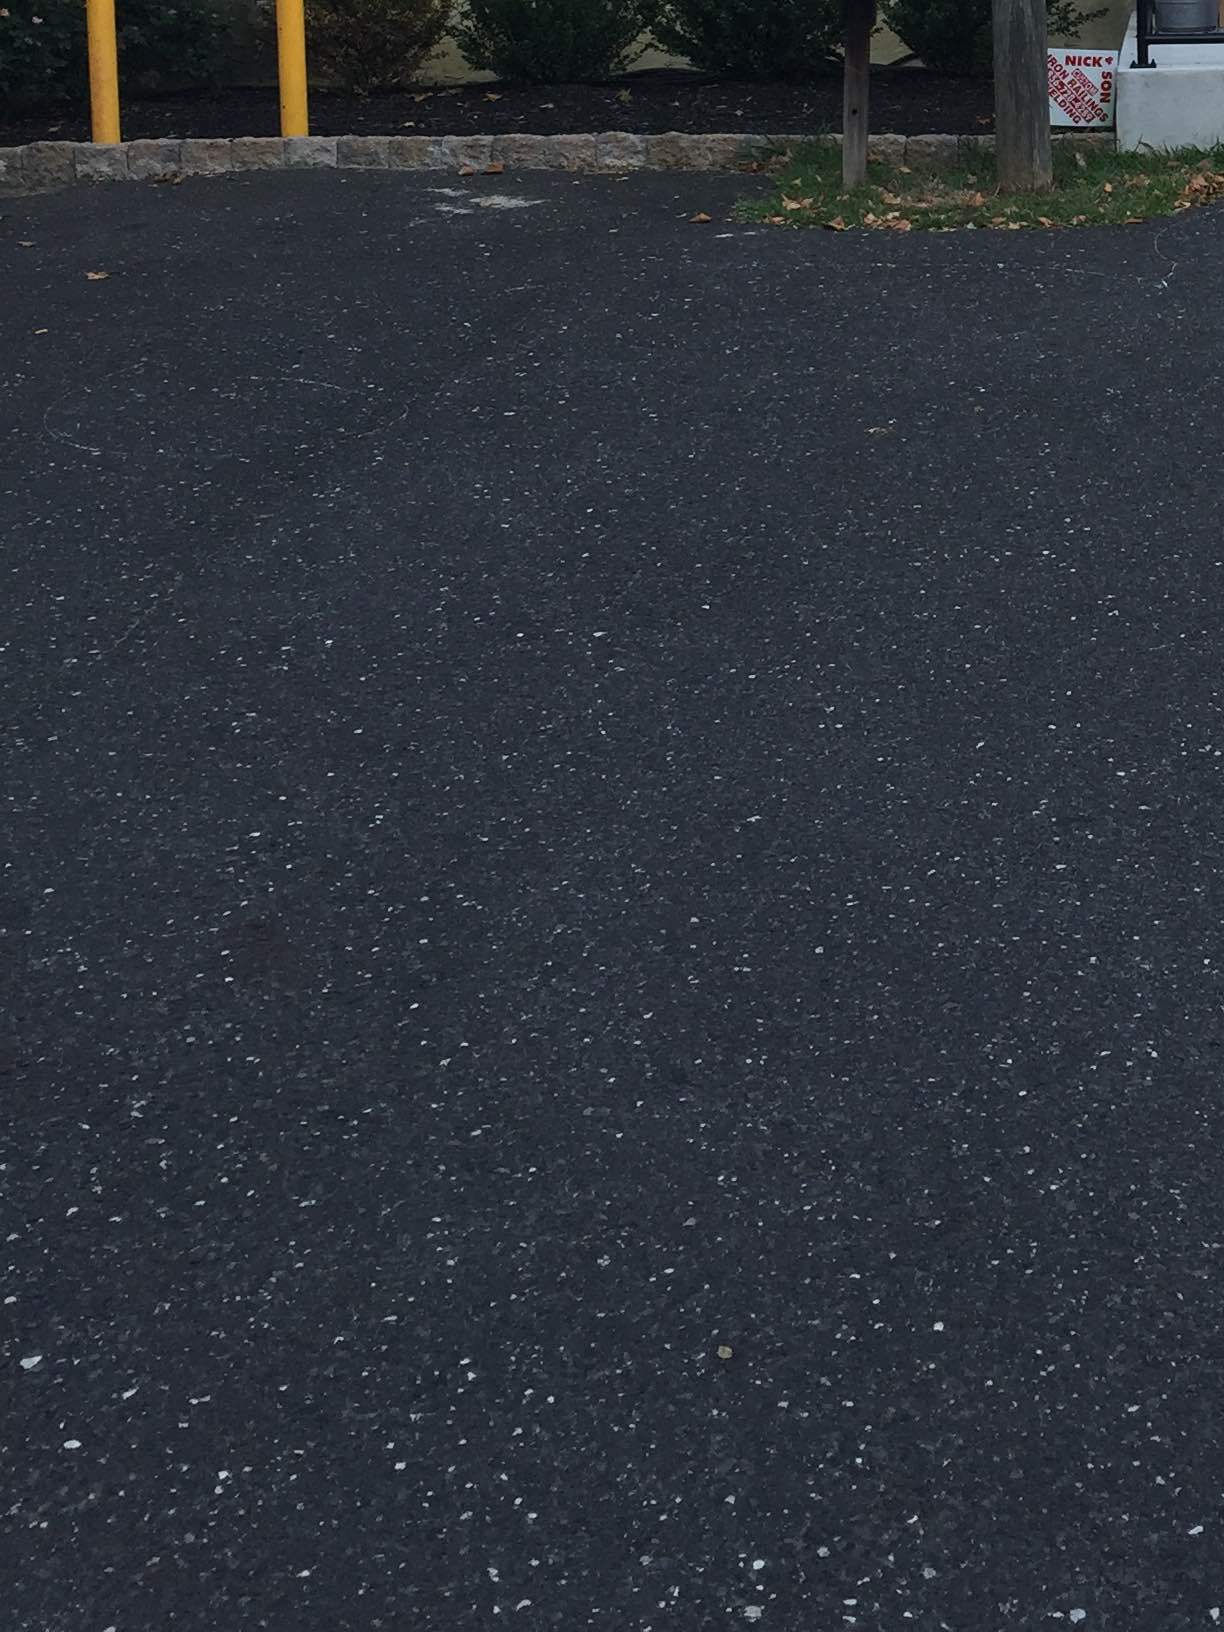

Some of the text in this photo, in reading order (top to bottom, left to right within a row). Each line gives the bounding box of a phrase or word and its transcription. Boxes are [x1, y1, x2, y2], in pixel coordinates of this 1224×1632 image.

[1065, 55, 1102, 67] NICK
[1067, 79, 1108, 122] RAILINGS
[1100, 71, 1112, 103] SON
